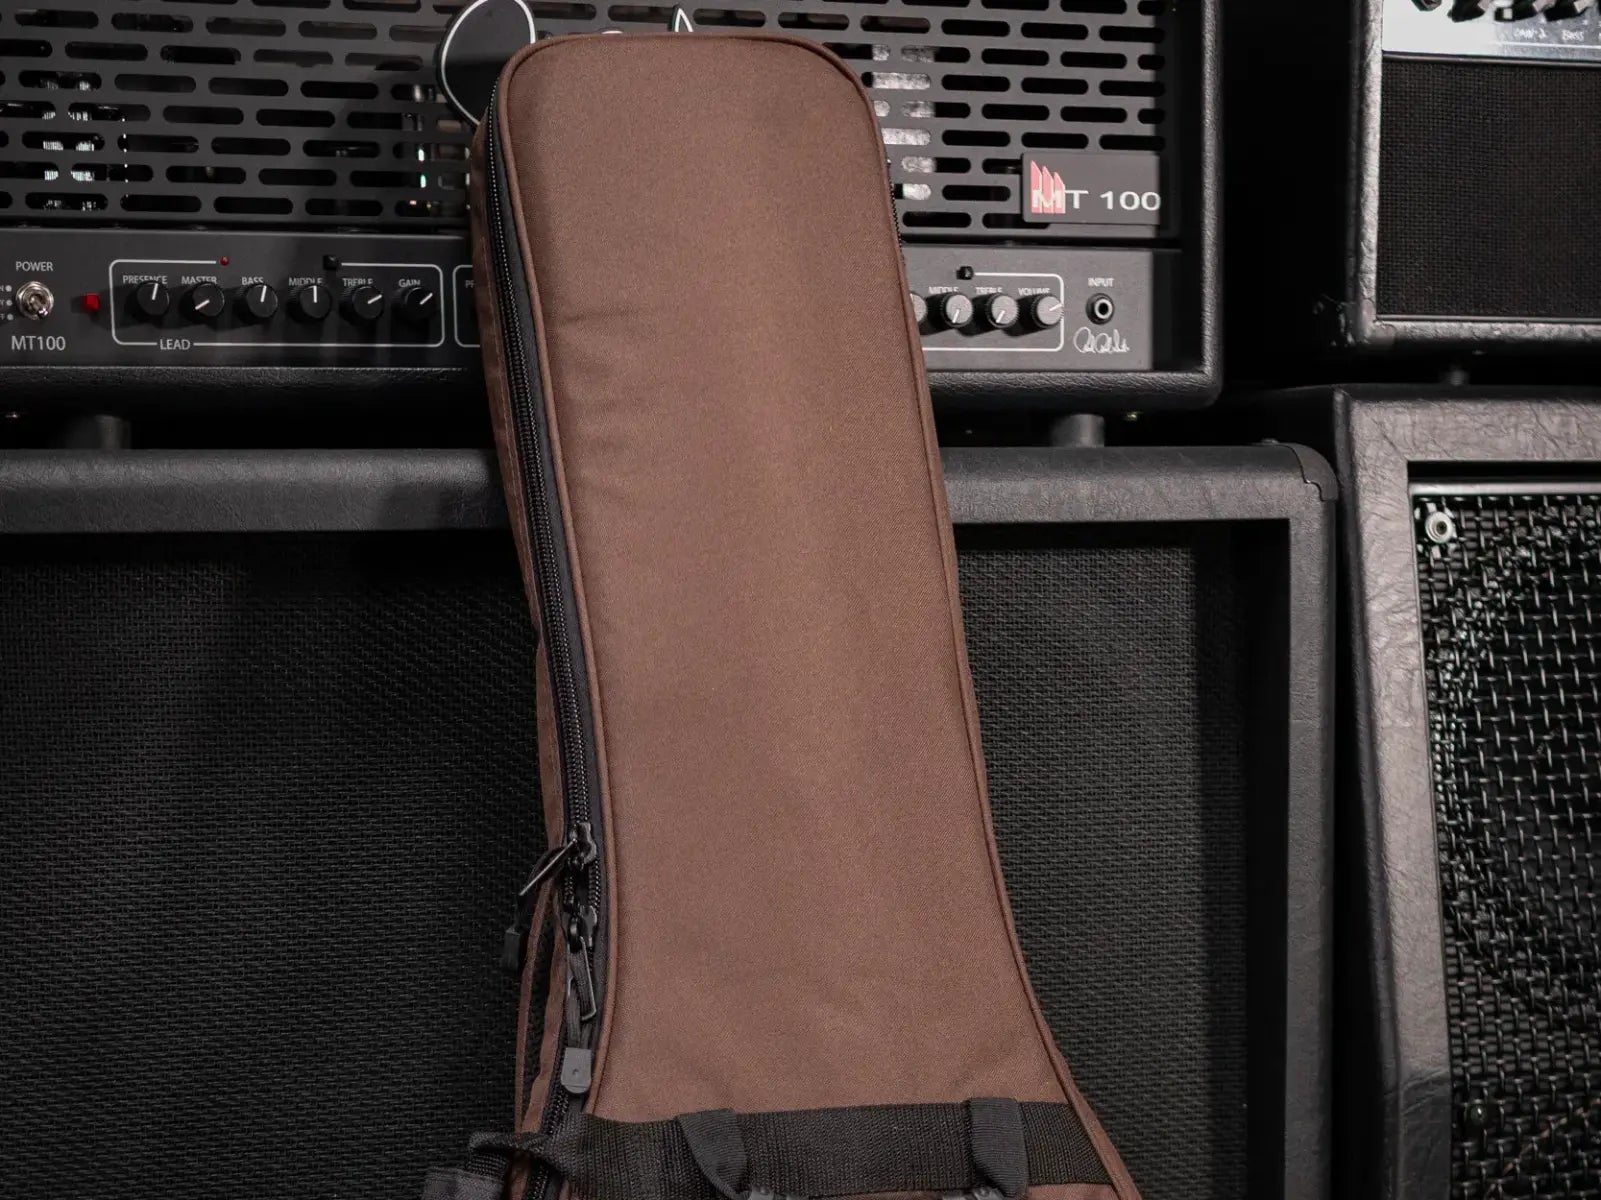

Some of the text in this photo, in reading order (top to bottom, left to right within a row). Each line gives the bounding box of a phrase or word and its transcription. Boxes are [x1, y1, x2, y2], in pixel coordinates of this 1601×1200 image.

[1032, 189, 1161, 211] MT 100
[15, 261, 54, 272] POWER
[122, 275, 168, 285] PRESENCE
[181, 275, 217, 285] MASTER
[241, 276, 264, 286] BASS
[398, 278, 421, 288] GAIN
[1088, 277, 1114, 288] INPUT
[11, 335, 66, 351] MT100
[160, 339, 191, 351] LEAD
